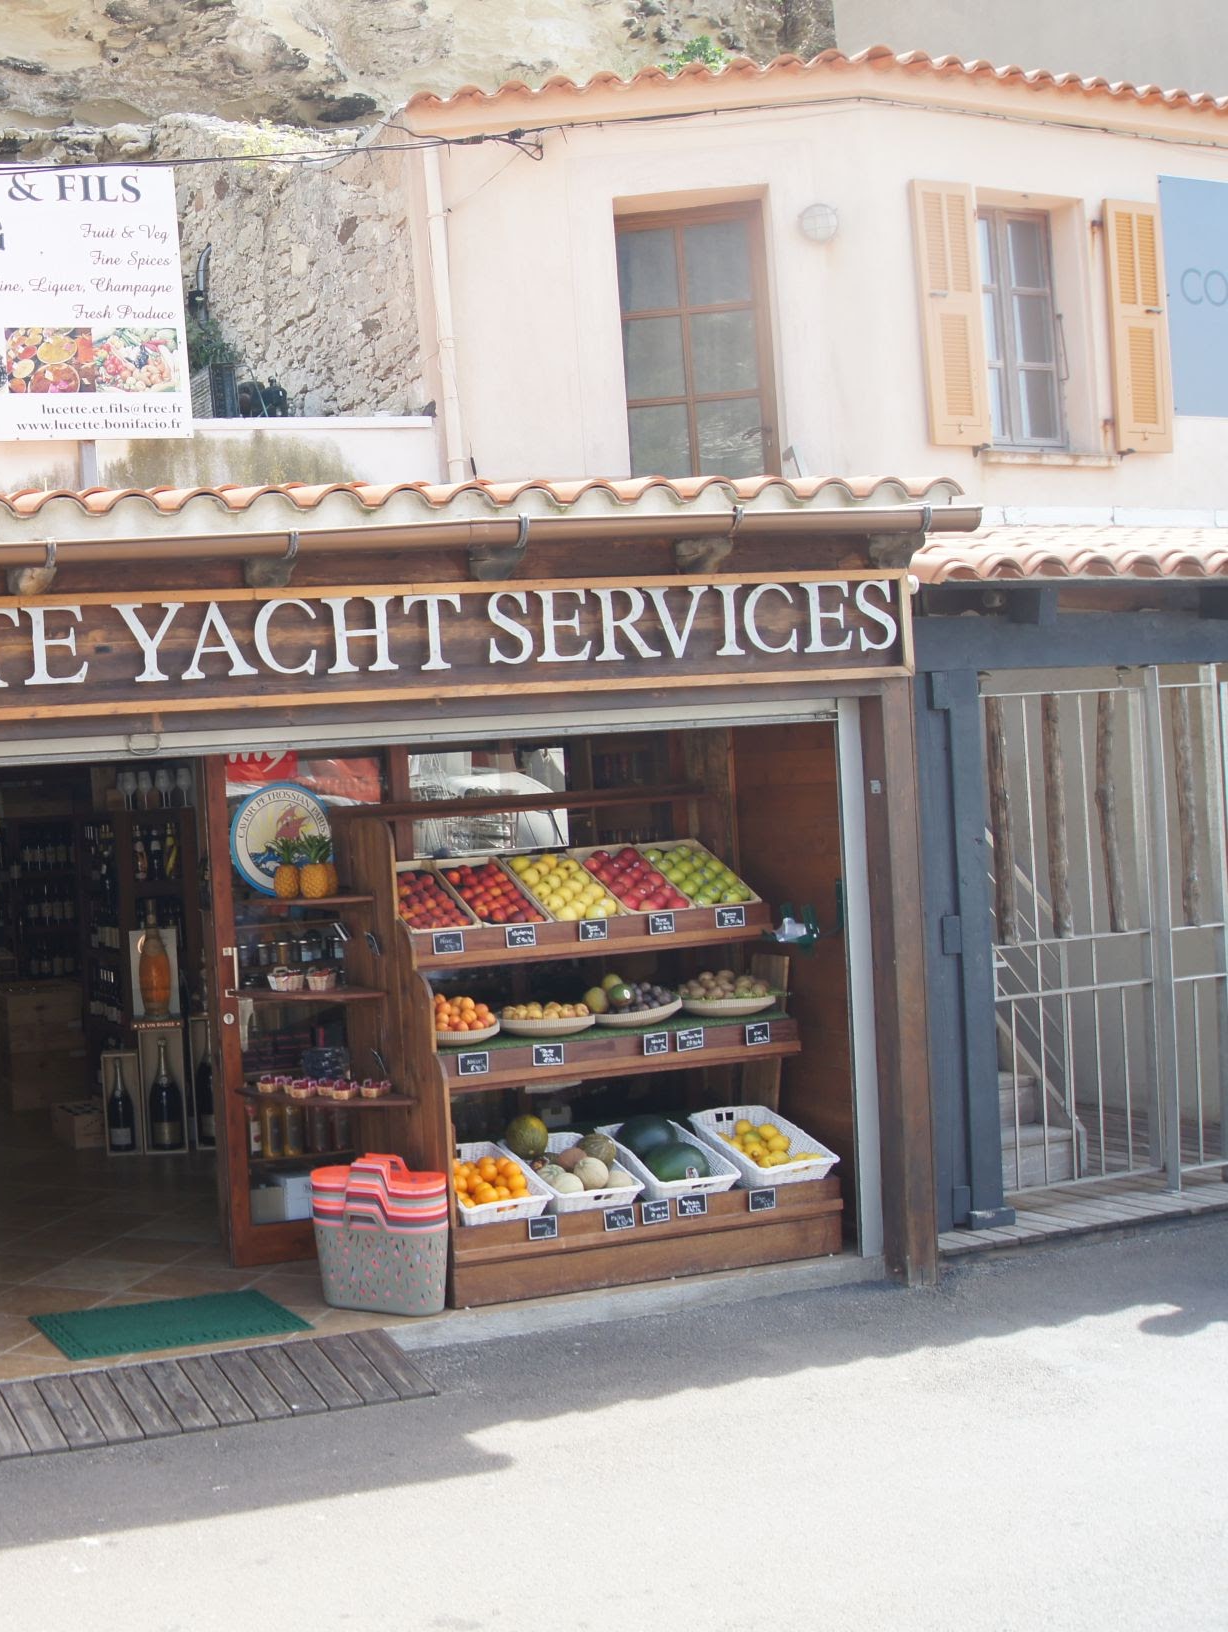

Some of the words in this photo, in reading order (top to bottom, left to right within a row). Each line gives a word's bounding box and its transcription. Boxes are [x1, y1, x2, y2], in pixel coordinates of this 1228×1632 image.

[7, 173, 43, 201] &
[55, 174, 142, 202] FILS
[79, 223, 117, 239] Fruit
[121, 226, 135, 239] &
[138, 224, 170, 244] Veg
[89, 250, 122, 266] Fine
[127, 250, 173, 270] Spices
[90, 277, 173, 297] Champagne
[71, 304, 113, 320] Fresh
[116, 305, 177, 320] Produce
[41, 403, 184, 415] lucette.et.fils@free.fr
[16, 418, 182, 431] www.lucette.bonifacio.fr
[111, 593, 461, 683] YACHT
[487, 579, 897, 664] SERVICES
[238, 806, 256, 839] CAVIAR
[311, 806, 328, 834] PARIS
